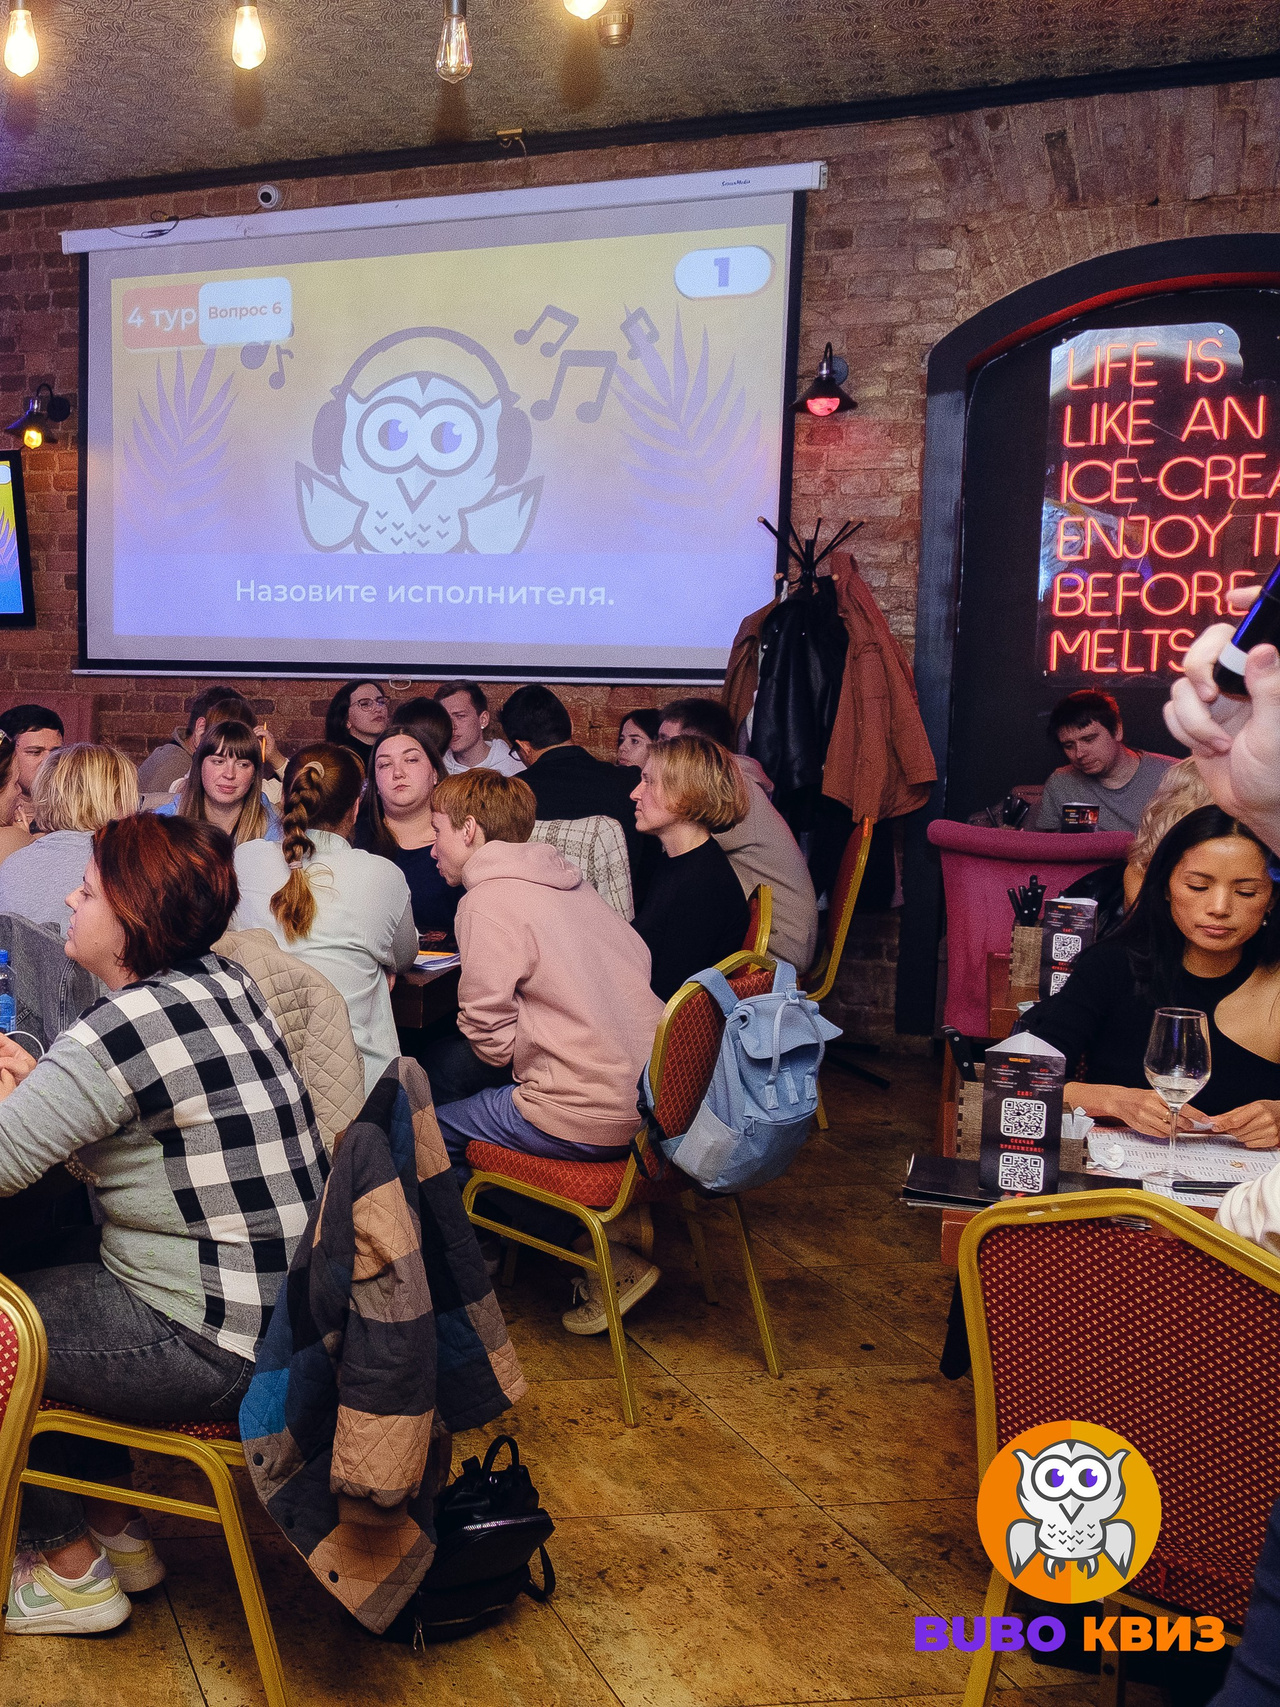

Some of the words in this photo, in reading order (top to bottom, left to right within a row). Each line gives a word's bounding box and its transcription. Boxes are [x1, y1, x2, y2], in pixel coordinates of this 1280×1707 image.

[714, 257, 730, 287] 1
[127, 306, 144, 328] 4
[150, 307, 197, 331] тур
[208, 305, 267, 320] Вопрос
[272, 302, 282, 314] 6
[1067, 341, 1158, 391] LIFE
[1184, 337, 1226, 384] IS
[1063, 399, 1154, 447] LIKE
[1181, 394, 1265, 442] AN
[1056, 513, 1233, 561] ENJOY
[235, 580, 378, 603] Назовите
[388, 584, 615, 606] исполнителя.
[1052, 571, 1256, 617] BEFORE
